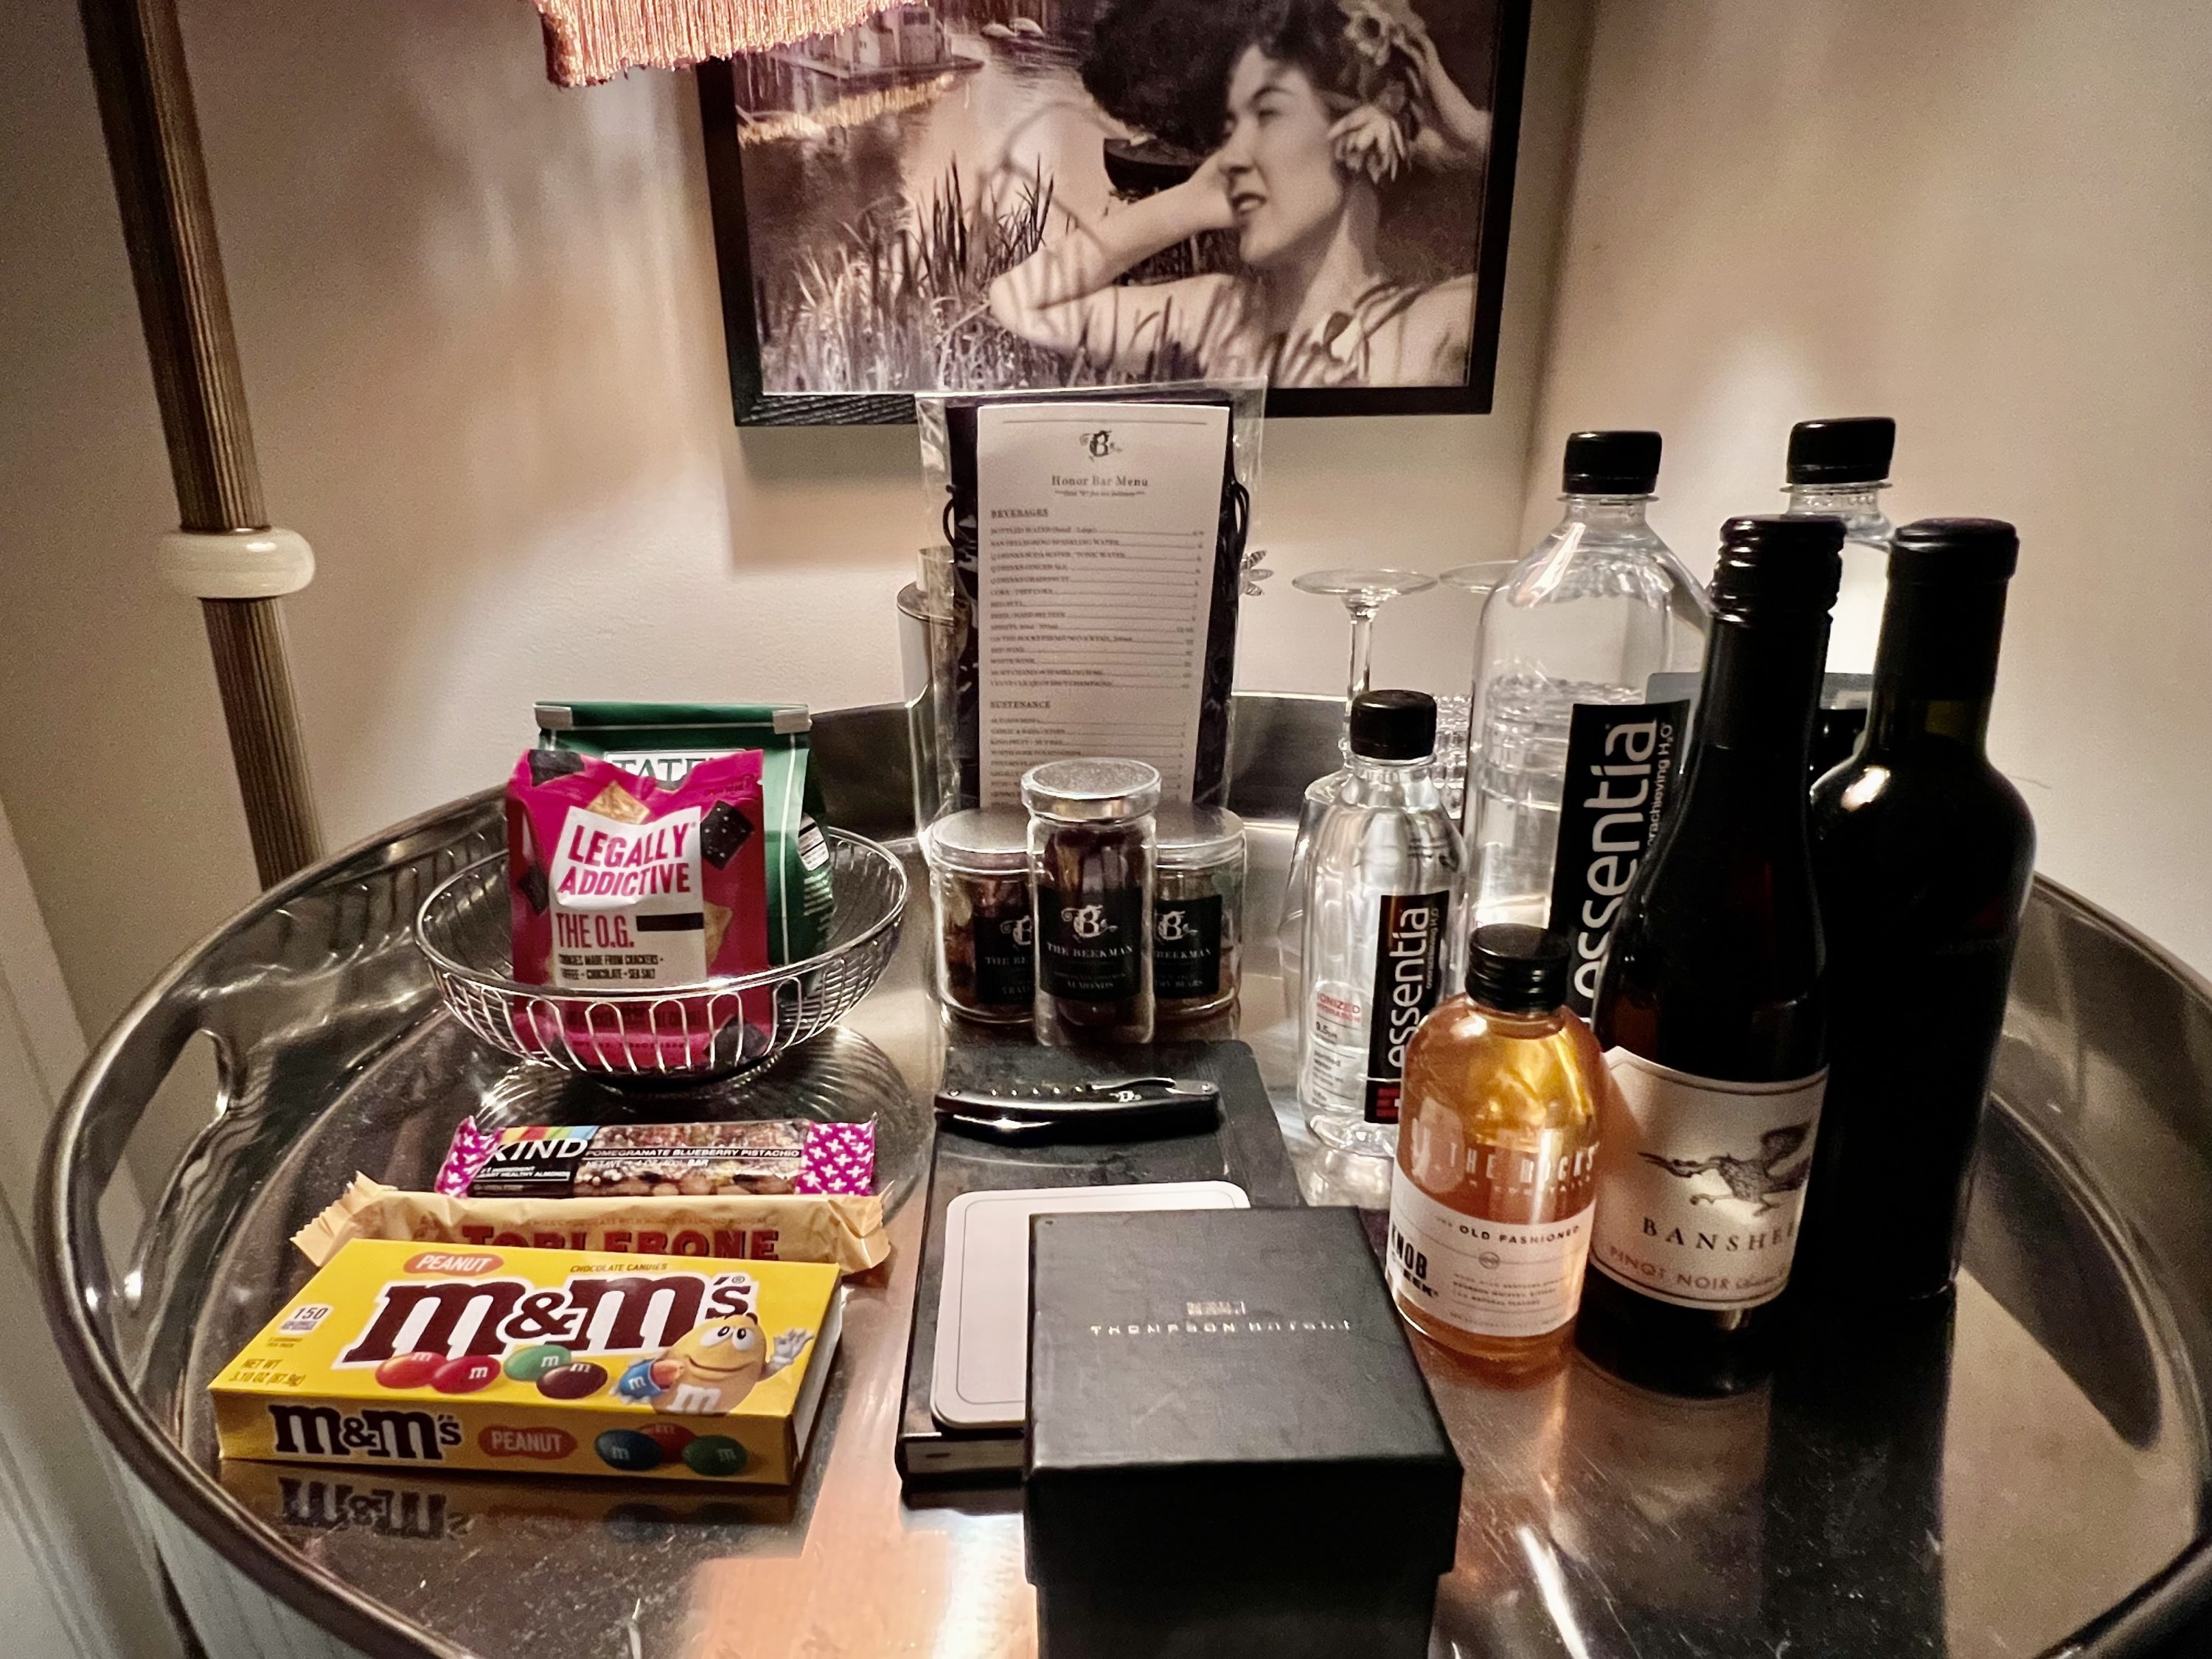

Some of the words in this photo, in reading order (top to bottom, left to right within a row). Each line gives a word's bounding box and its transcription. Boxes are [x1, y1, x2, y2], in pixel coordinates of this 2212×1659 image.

[1051, 475, 1088, 486] Honor
[1092, 475, 1112, 486] Bar
[1116, 475, 1148, 486] Menu
[990, 701, 1051, 709] SUSTENANCE
[1648, 758, 1671, 847] rachieving
[568, 822, 692, 869] LEGALLY
[1574, 719, 1657, 998] essentia
[557, 863, 690, 896] ADDICTIVE
[555, 912, 592, 948] THE
[594, 914, 635, 948] O.G.
[1046, 942, 1069, 954] THE
[1074, 945, 1133, 958] BEEKMAN
[1388, 908, 1429, 1068] essentia
[494, 1139, 588, 1162] KIND
[740, 1149, 800, 1157] PISTACHIO
[1459, 1225, 1490, 1240] OLD
[1499, 1225, 1579, 1245] FASHIONED
[416, 1253, 493, 1273] PEANUT
[570, 1264, 623, 1273] CHOCOLATE
[1609, 1245, 1667, 1280] PINOT
[1677, 1273, 1730, 1290] NOIR
[294, 1307, 329, 1320] 150
[540, 1356, 560, 1368] m
[570, 1362, 591, 1373] m
[468, 1366, 489, 1380] m
[627, 1377, 647, 1389] m
[667, 1383, 722, 1414] m
[491, 1430, 562, 1454] PEANUT
